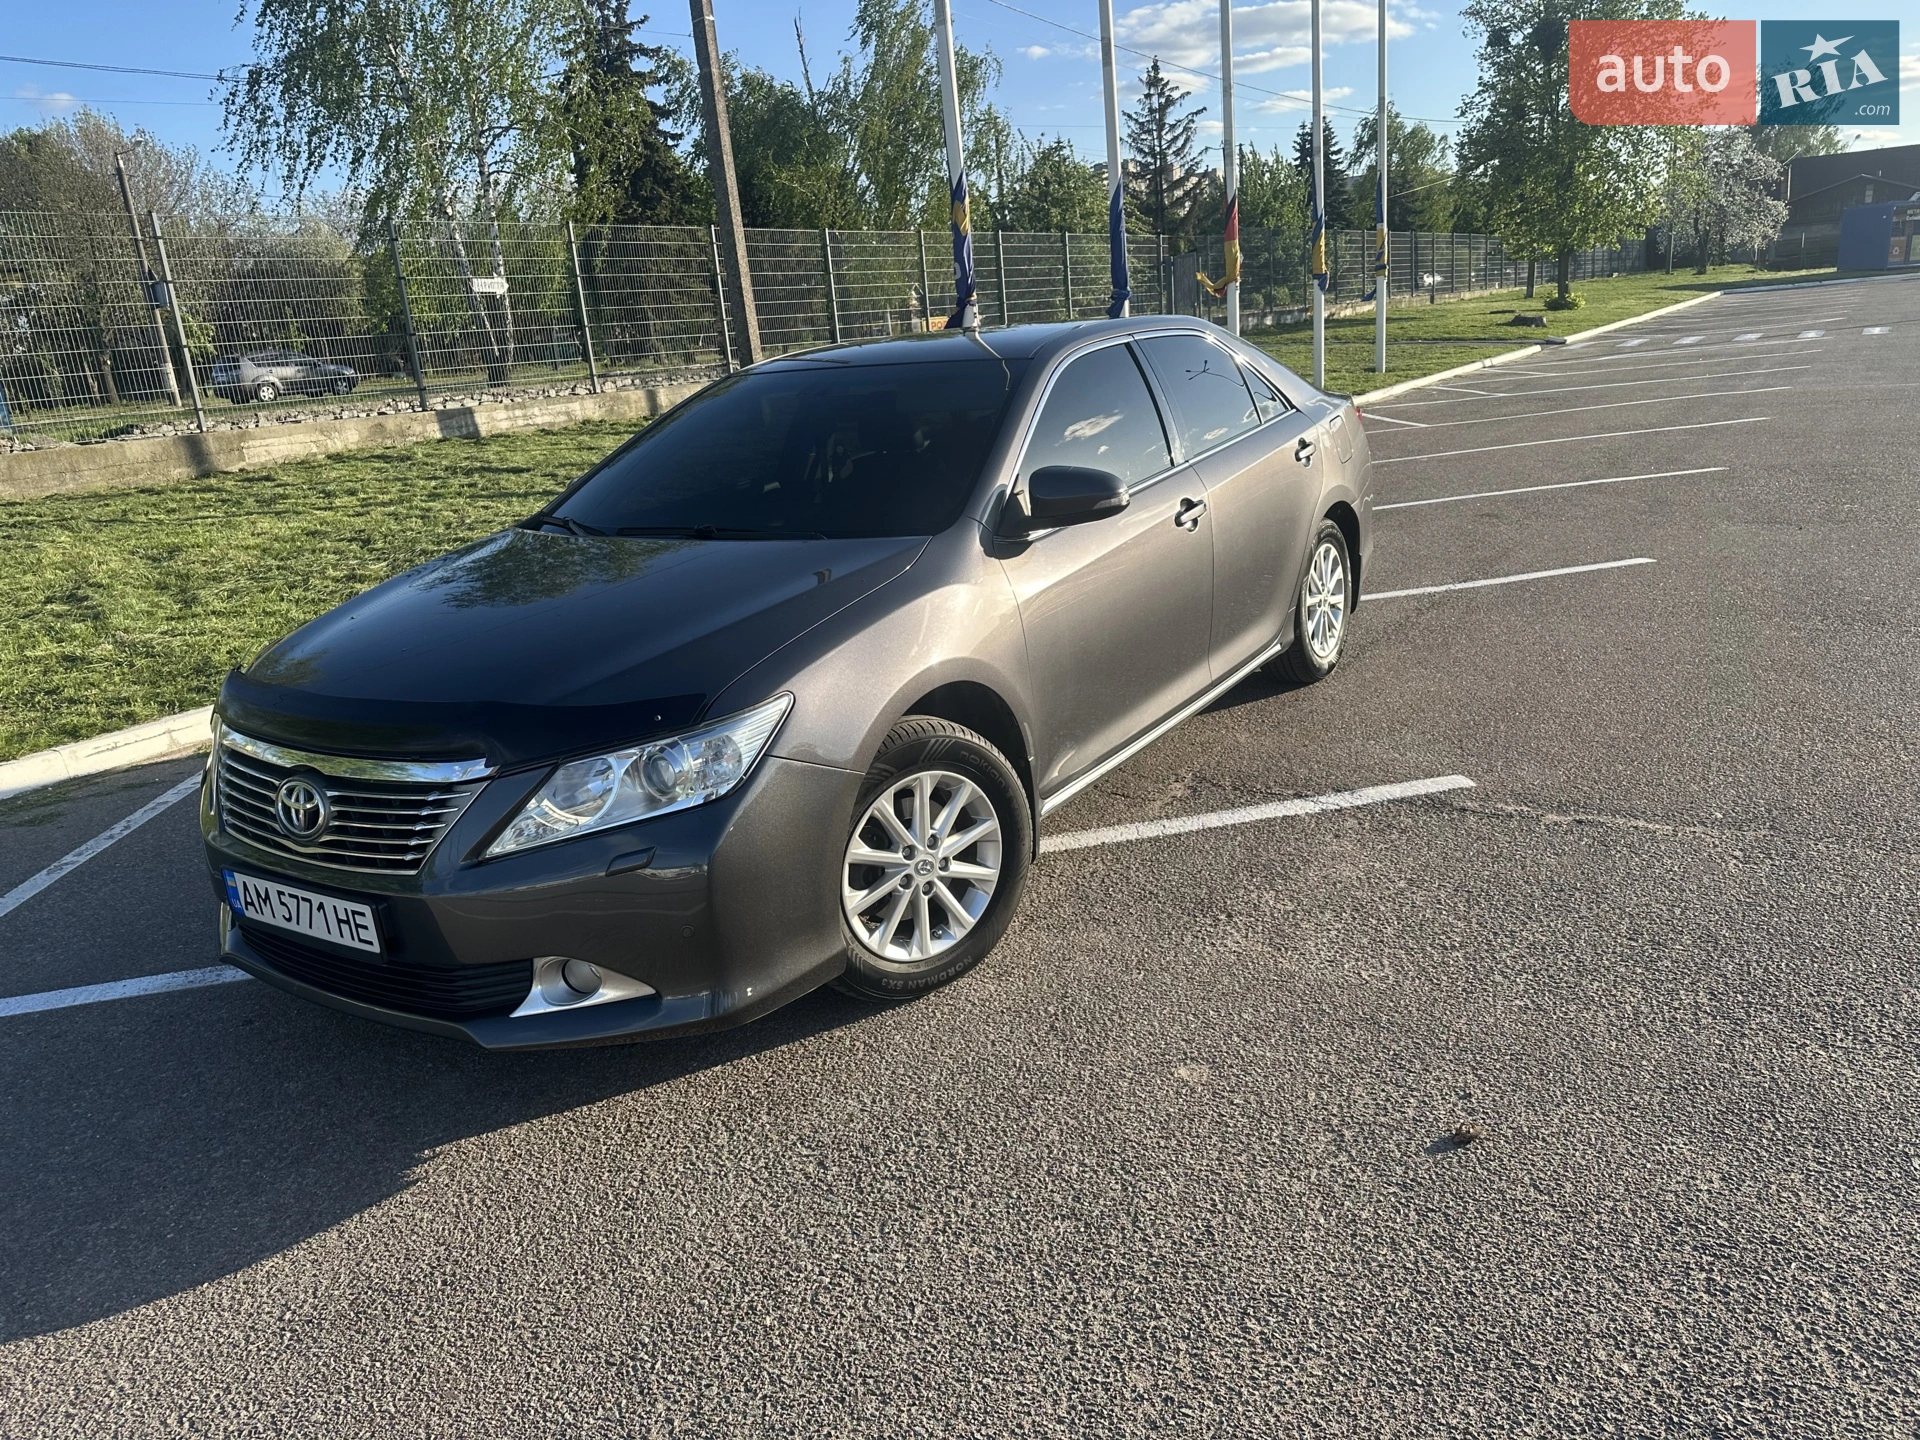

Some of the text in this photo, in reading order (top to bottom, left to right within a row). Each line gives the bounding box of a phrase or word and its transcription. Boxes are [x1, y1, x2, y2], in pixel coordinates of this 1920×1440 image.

[959, 750, 1007, 788] nokian
[231, 897, 243, 910] UA
[242, 880, 374, 946] AM 5771 HE
[907, 955, 973, 989] NORDMAN
